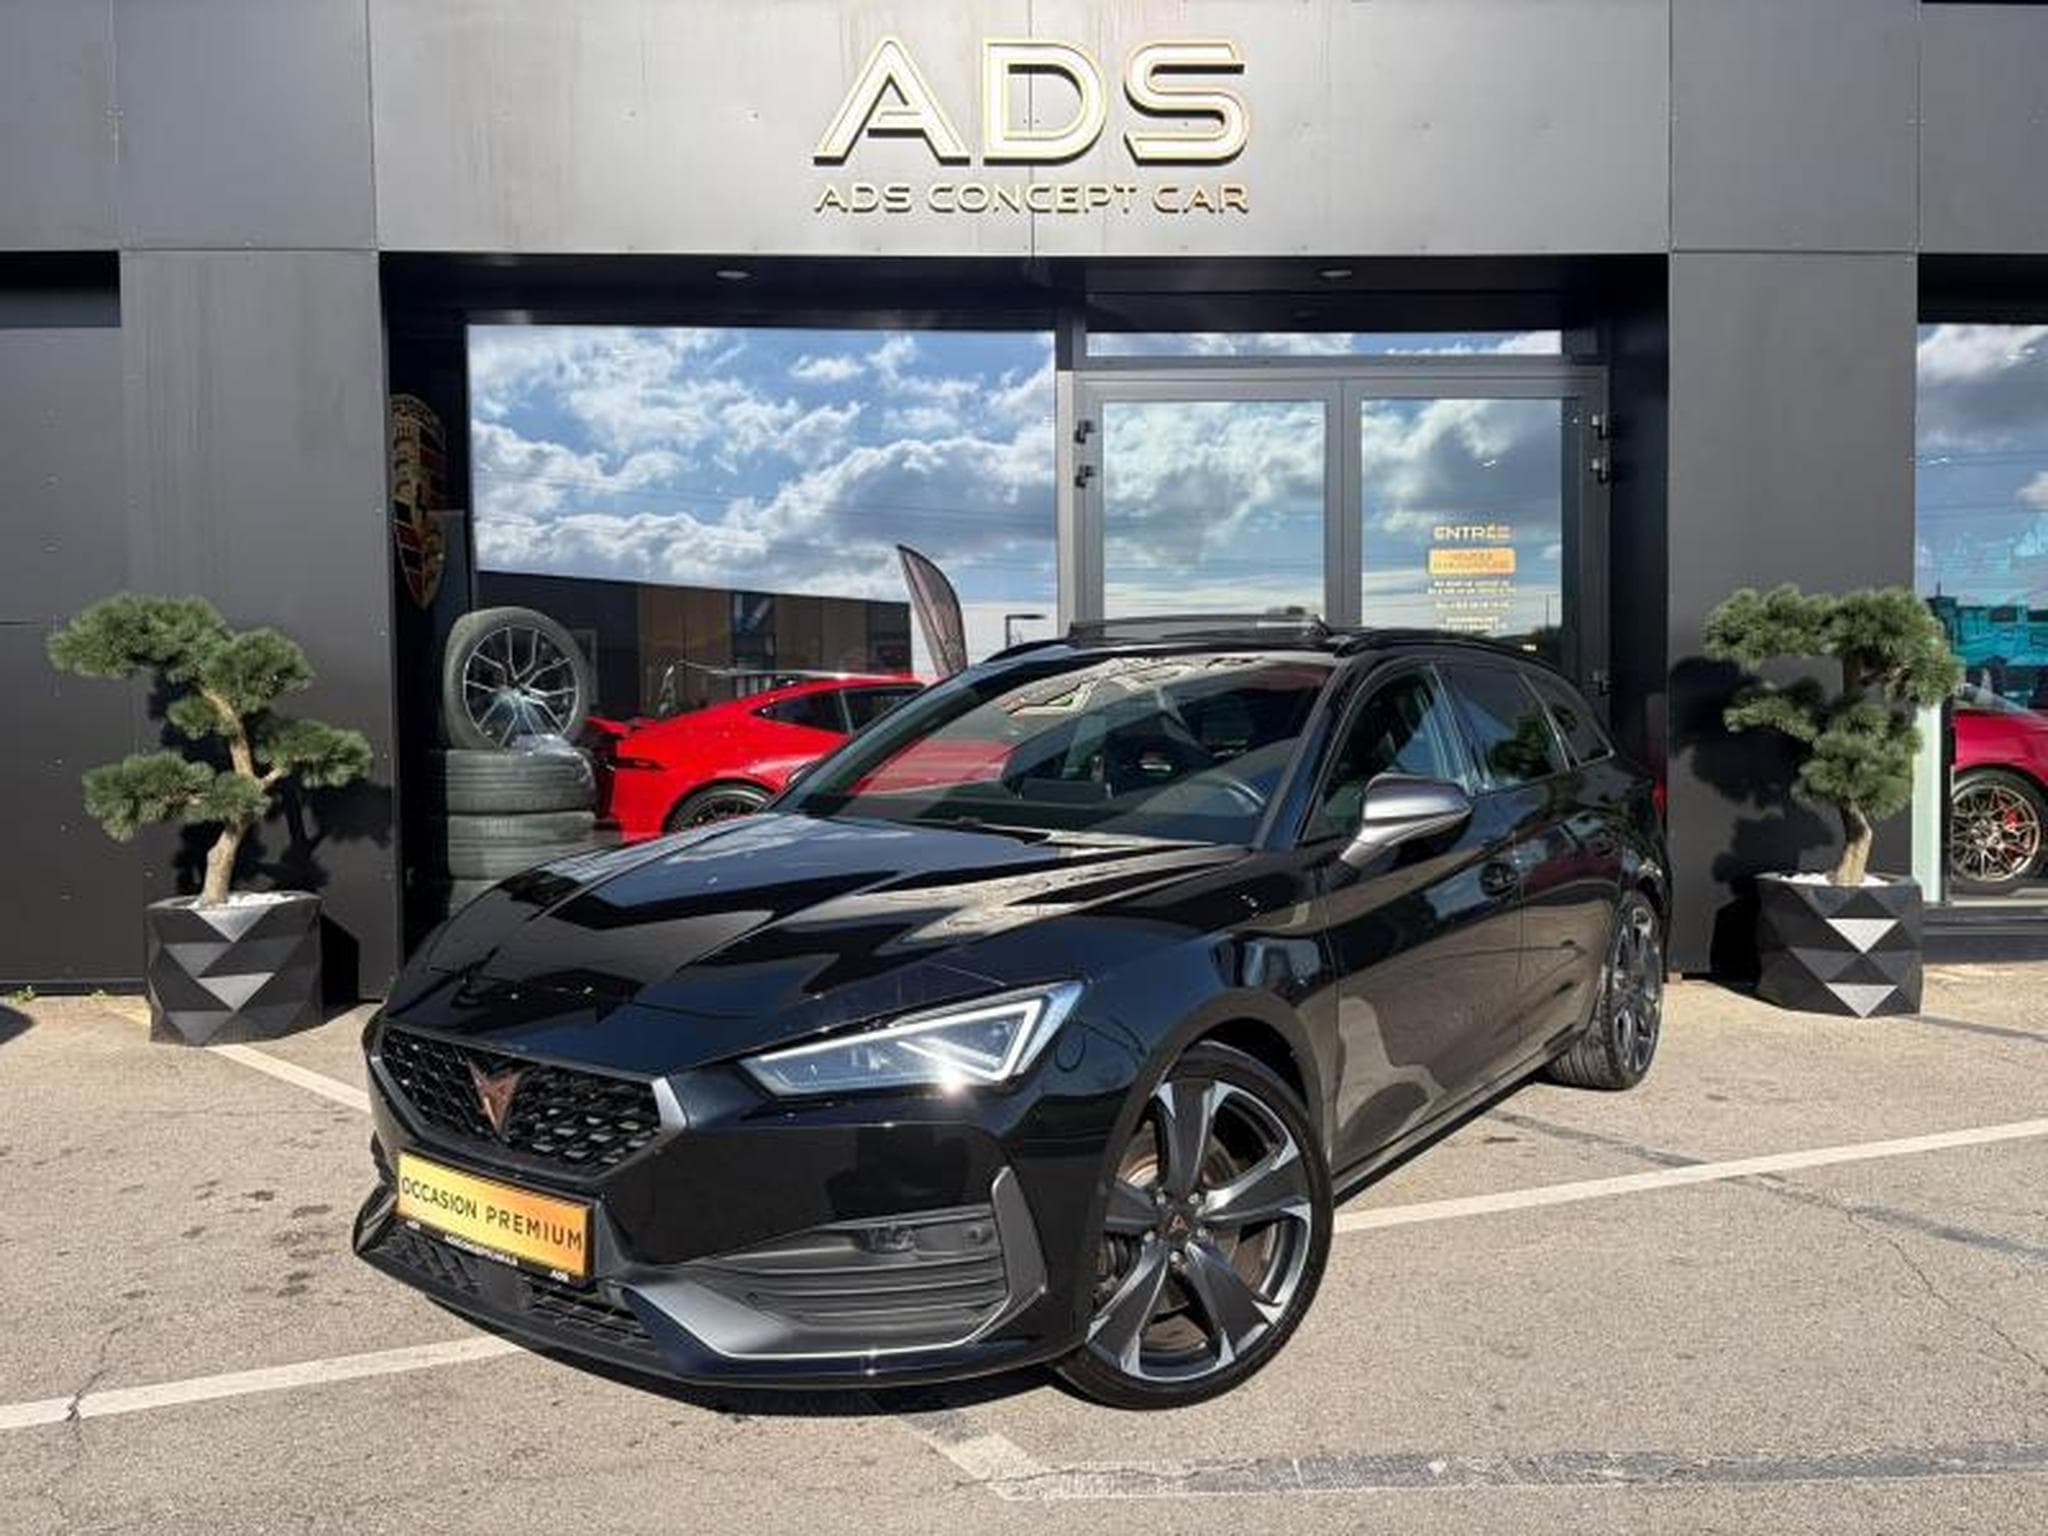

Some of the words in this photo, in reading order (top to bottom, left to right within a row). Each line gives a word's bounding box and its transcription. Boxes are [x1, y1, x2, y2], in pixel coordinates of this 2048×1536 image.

[813, 35, 1251, 167] ADS
[814, 184, 911, 213] ADS
[927, 184, 1138, 213] CONCEPT
[1153, 184, 1251, 213] CAR
[401, 1176, 478, 1220] OCCASION
[485, 1205, 583, 1250] PREMIUM
